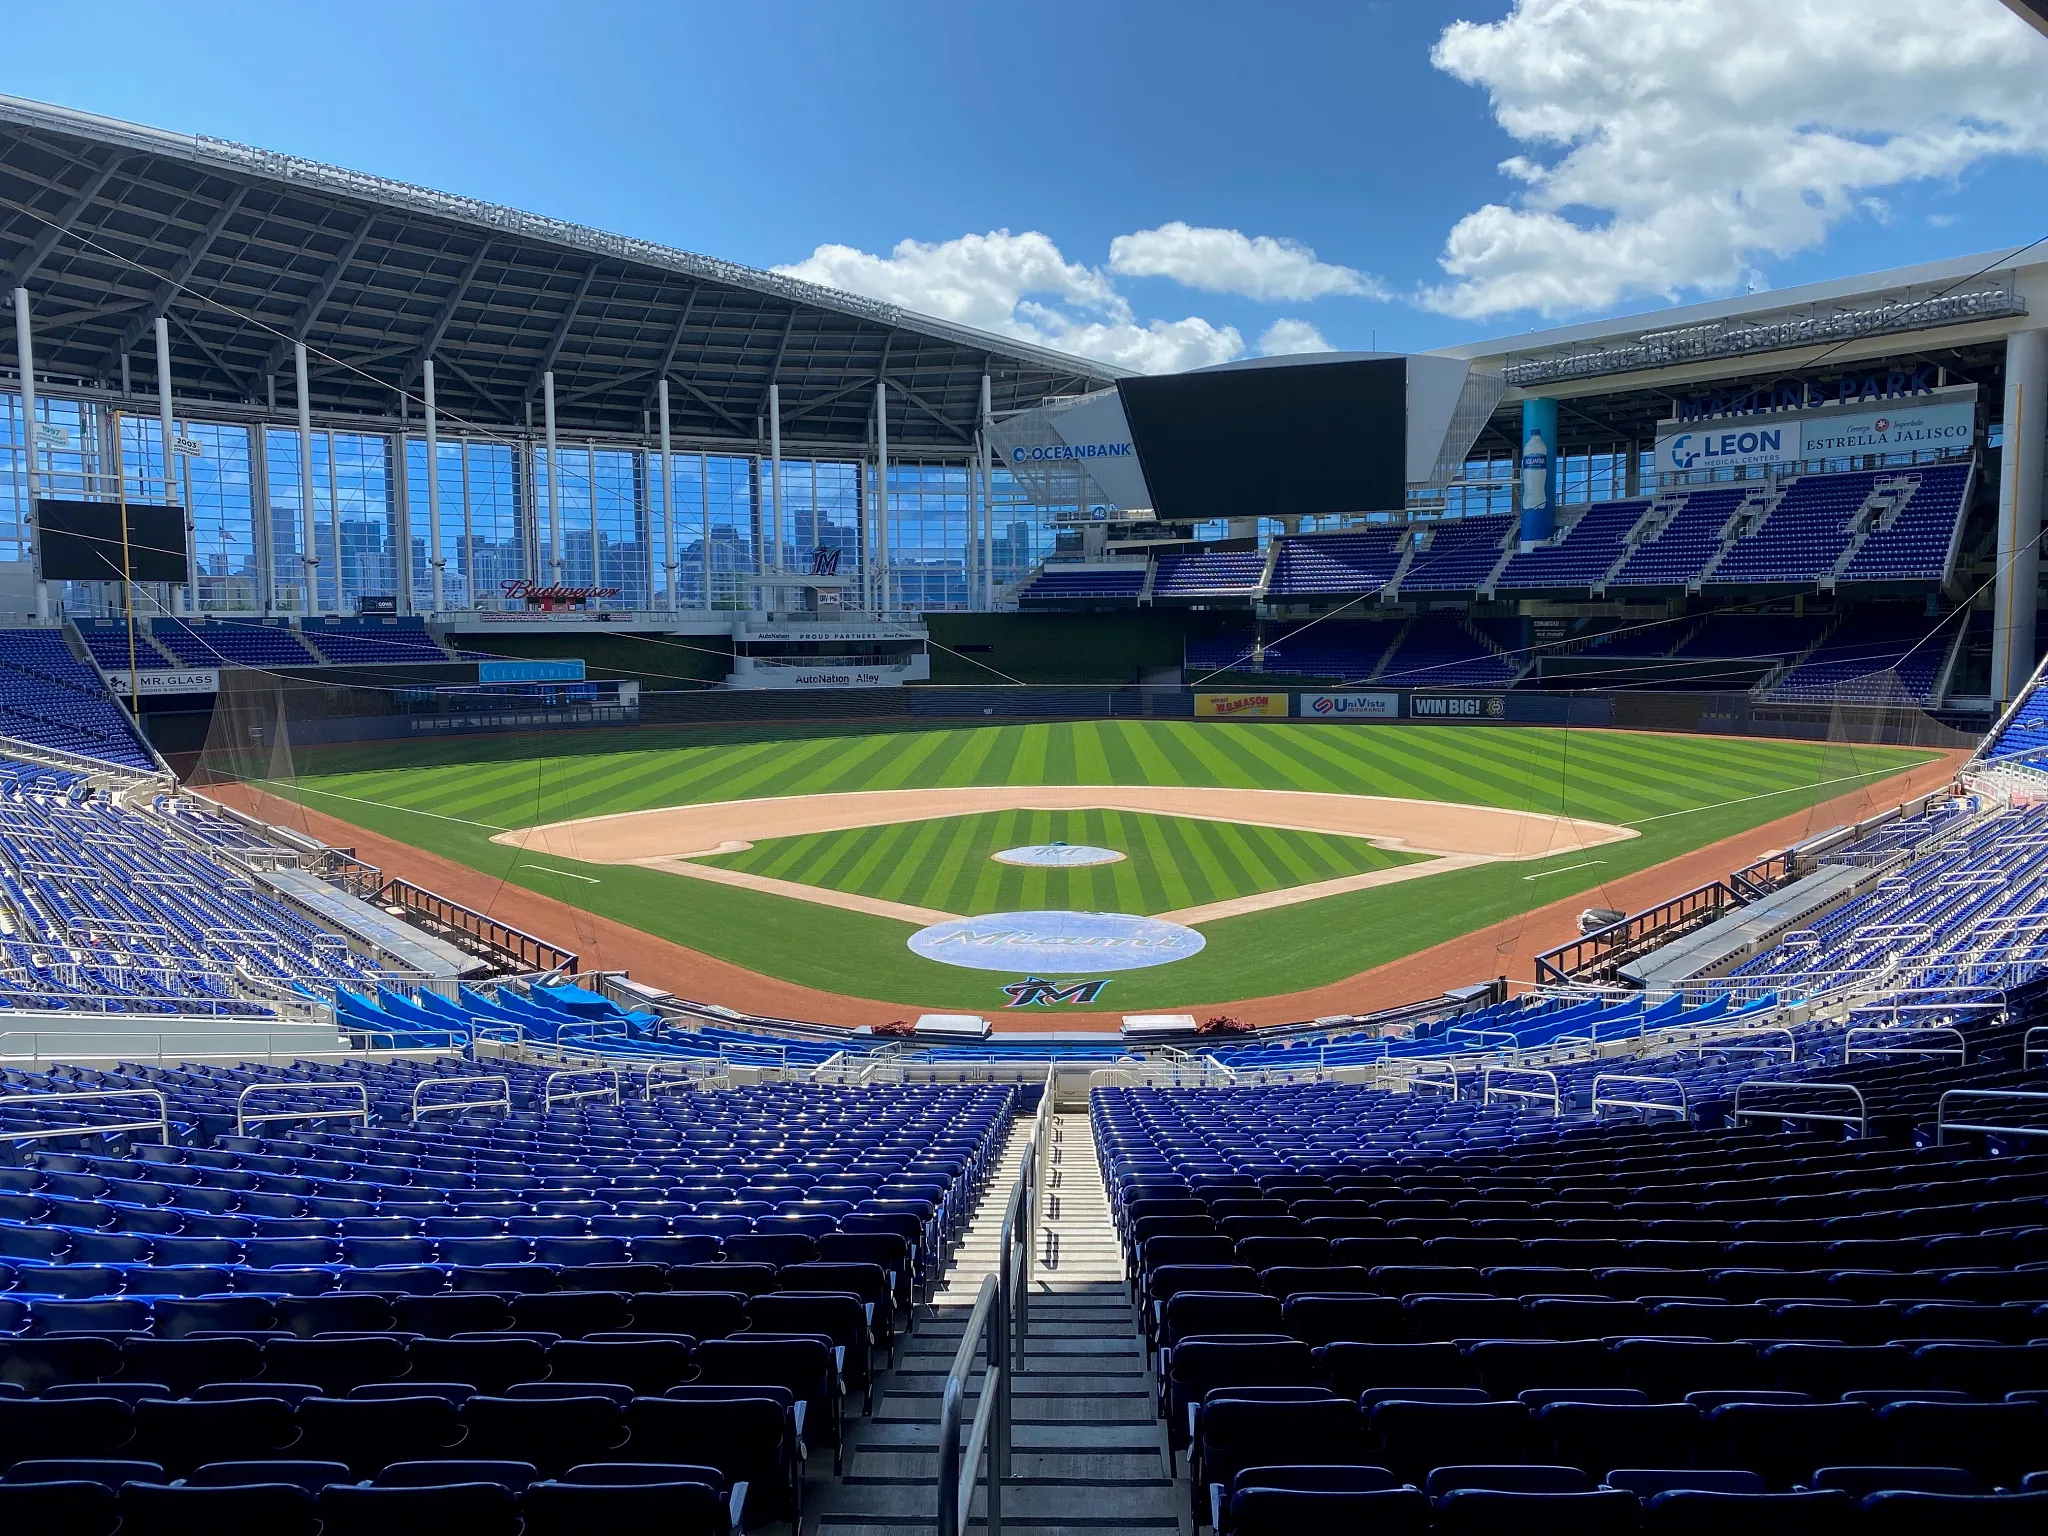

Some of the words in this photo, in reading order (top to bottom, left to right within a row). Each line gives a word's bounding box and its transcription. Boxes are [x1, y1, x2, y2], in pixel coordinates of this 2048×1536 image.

[1678, 381, 1825, 422] MARLINS
[1838, 367, 1934, 405] PARK
[177, 438, 197, 448] 2003
[1704, 430, 1780, 457] LEON
[1806, 432, 1888, 450] ESTRELLA
[1894, 425, 1967, 443] JALISCO
[1031, 443, 1131, 460] OCEANBANK
[1524, 458, 1545, 466] AQUAFINA
[1704, 458, 1740, 467] MEDICAL
[1742, 454, 1780, 464] CENTERS
[1094, 509, 1106, 517] 42
[501, 579, 621, 599] Budweiser
[482, 666, 581, 679] CLEVELANDER
[796, 675, 849, 684] AutoNation
[856, 673, 879, 684] Alley
[140, 677, 165, 686] MR.
[168, 675, 212, 685] GLASS
[1334, 698, 1385, 712] UniVista
[1416, 699, 1447, 714] WIN
[1449, 699, 1480, 714] BIG!
[923, 930, 1187, 948] Miami
